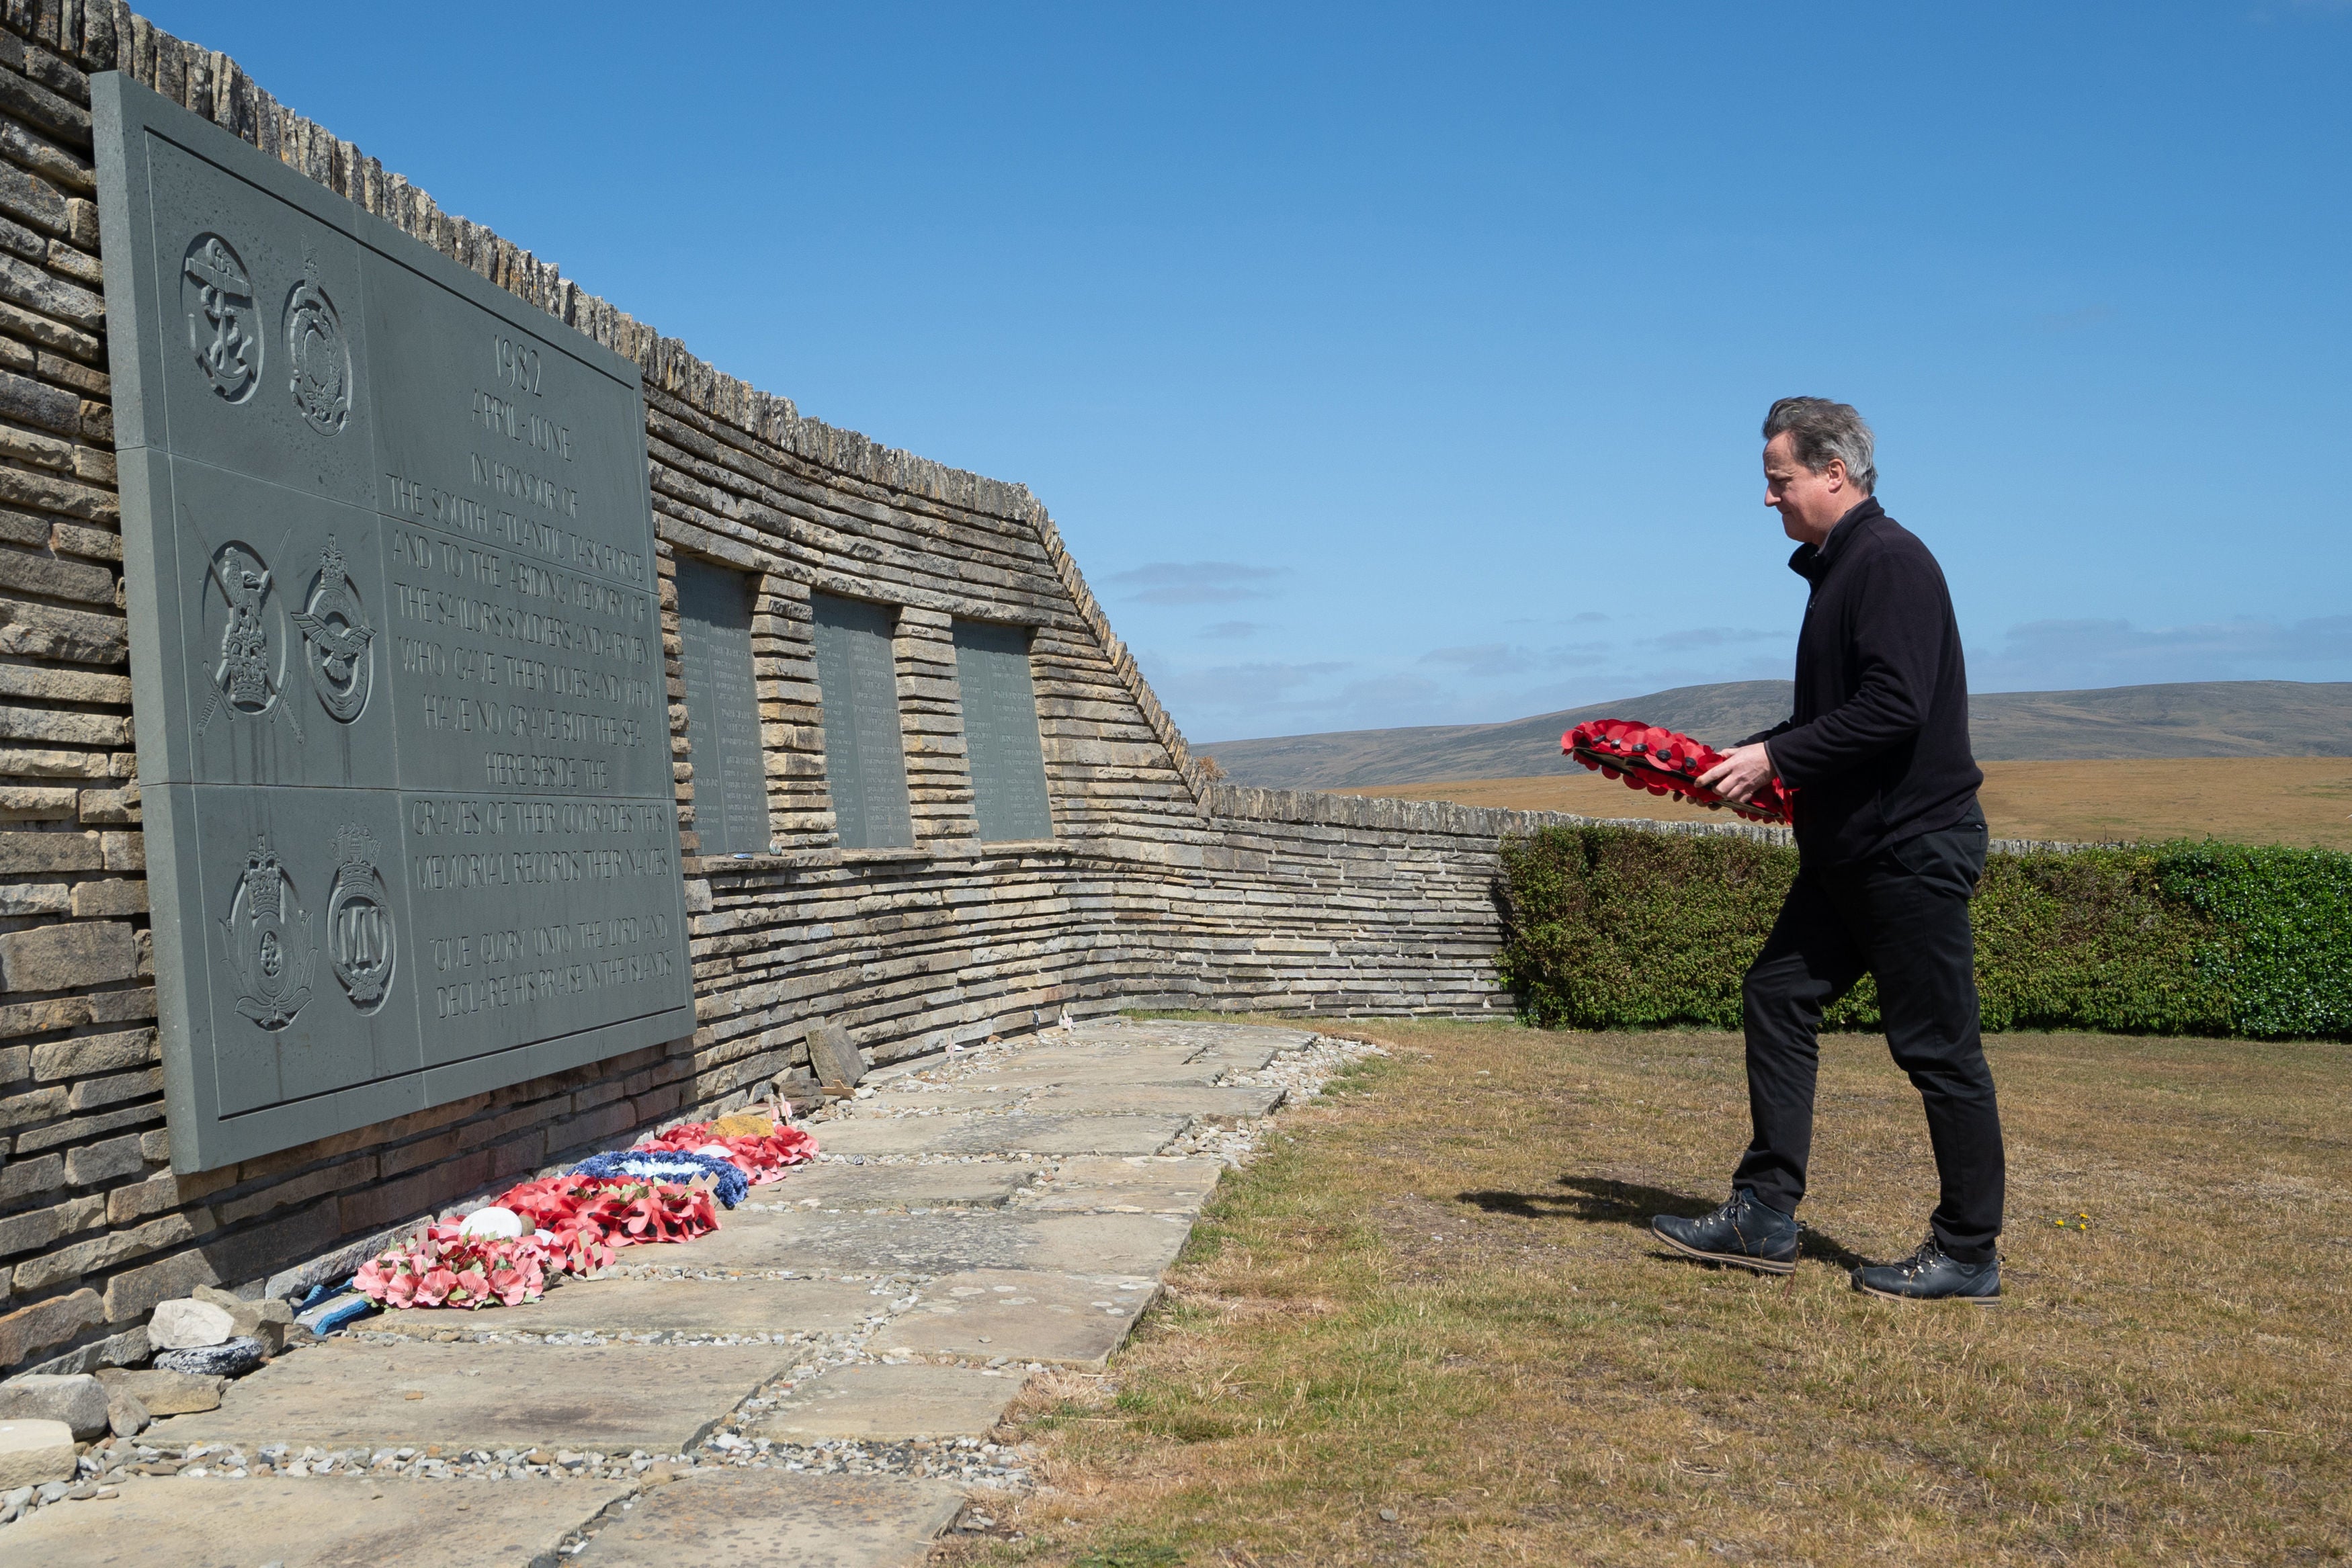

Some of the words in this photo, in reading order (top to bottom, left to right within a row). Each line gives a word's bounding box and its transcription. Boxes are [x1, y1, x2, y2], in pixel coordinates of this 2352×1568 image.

[495, 335, 543, 398] 1982
[471, 451, 489, 487] IN
[495, 461, 557, 511] HONOUR
[562, 486, 579, 519] OF
[386, 473, 424, 516] THE
[431, 488, 488, 534] SOUTH
[496, 509, 565, 560] ATLANTIC
[569, 533, 603, 570] TASK
[605, 545, 643, 582] FORCE
[392, 530, 432, 570] AND
[438, 541, 463, 578] TO
[468, 549, 502, 589] THE
[511, 560, 566, 604] ABIDING
[571, 578, 625, 618] MEMORY
[632, 595, 645, 623] OF
[394, 582, 433, 623] THE
[437, 591, 503, 638] SAILORS
[507, 607, 573, 651] SOLDIERS
[576, 623, 603, 656] AND
[605, 630, 651, 666] AIRMEN
[398, 636, 446, 677] WHO
[454, 646, 498, 685] GAVE
[503, 655, 548, 693] THEIR
[553, 664, 589, 699] LIVES
[594, 672, 620, 704] AND
[622, 677, 653, 709] WHO
[423, 693, 472, 732] HAVE
[476, 699, 501, 735] NO
[507, 703, 557, 740] GRAVE
[562, 711, 587, 742] BUT
[591, 715, 618, 746] THE
[485, 751, 527, 786] HERE
[532, 754, 577, 788] BESIDE
[581, 758, 609, 789] THE
[412, 800, 481, 836] GRAVES
[486, 801, 507, 834] OF
[512, 801, 558, 834] THEIR
[562, 803, 634, 834] COMRADES
[636, 805, 665, 834] THIS
[415, 853, 509, 891] MEMORIAL
[513, 850, 581, 885] RECORDS
[583, 848, 624, 881] THEIR
[626, 848, 668, 877] NAMES
[480, 929, 526, 965] GLORY
[534, 924, 572, 957] UNTO
[577, 920, 603, 950] THE
[609, 918, 640, 947] LORD
[645, 914, 668, 941] AND
[437, 975, 509, 1020] DECLARE
[513, 973, 536, 1005] HIS
[540, 964, 584, 1000] PRAISE
[587, 961, 600, 991] IN
[601, 957, 626, 988] THE
